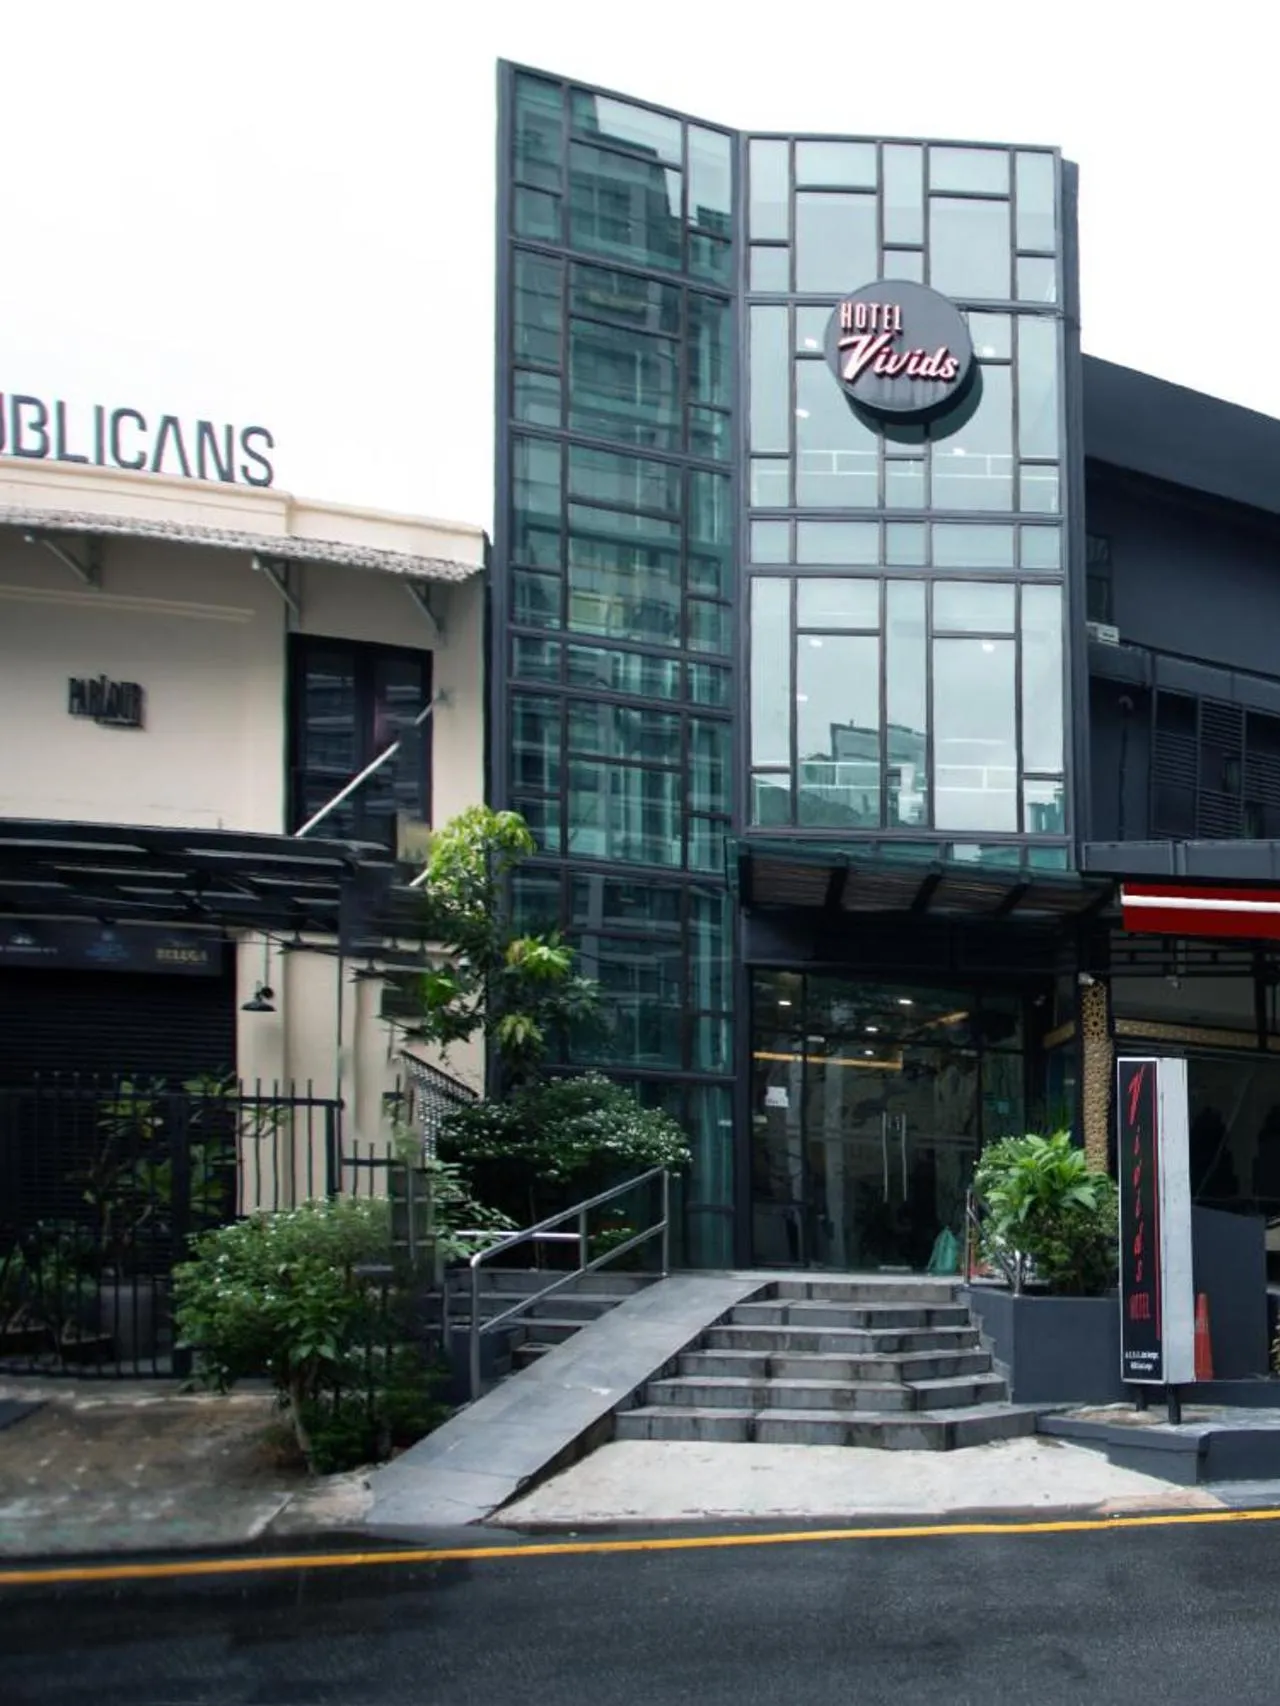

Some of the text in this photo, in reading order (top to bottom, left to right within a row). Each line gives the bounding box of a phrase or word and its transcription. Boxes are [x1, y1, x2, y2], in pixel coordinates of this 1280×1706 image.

[839, 302, 903, 331] HOTEL
[838, 332, 960, 382] Vivids
[0, 391, 275, 487] BLICANS
